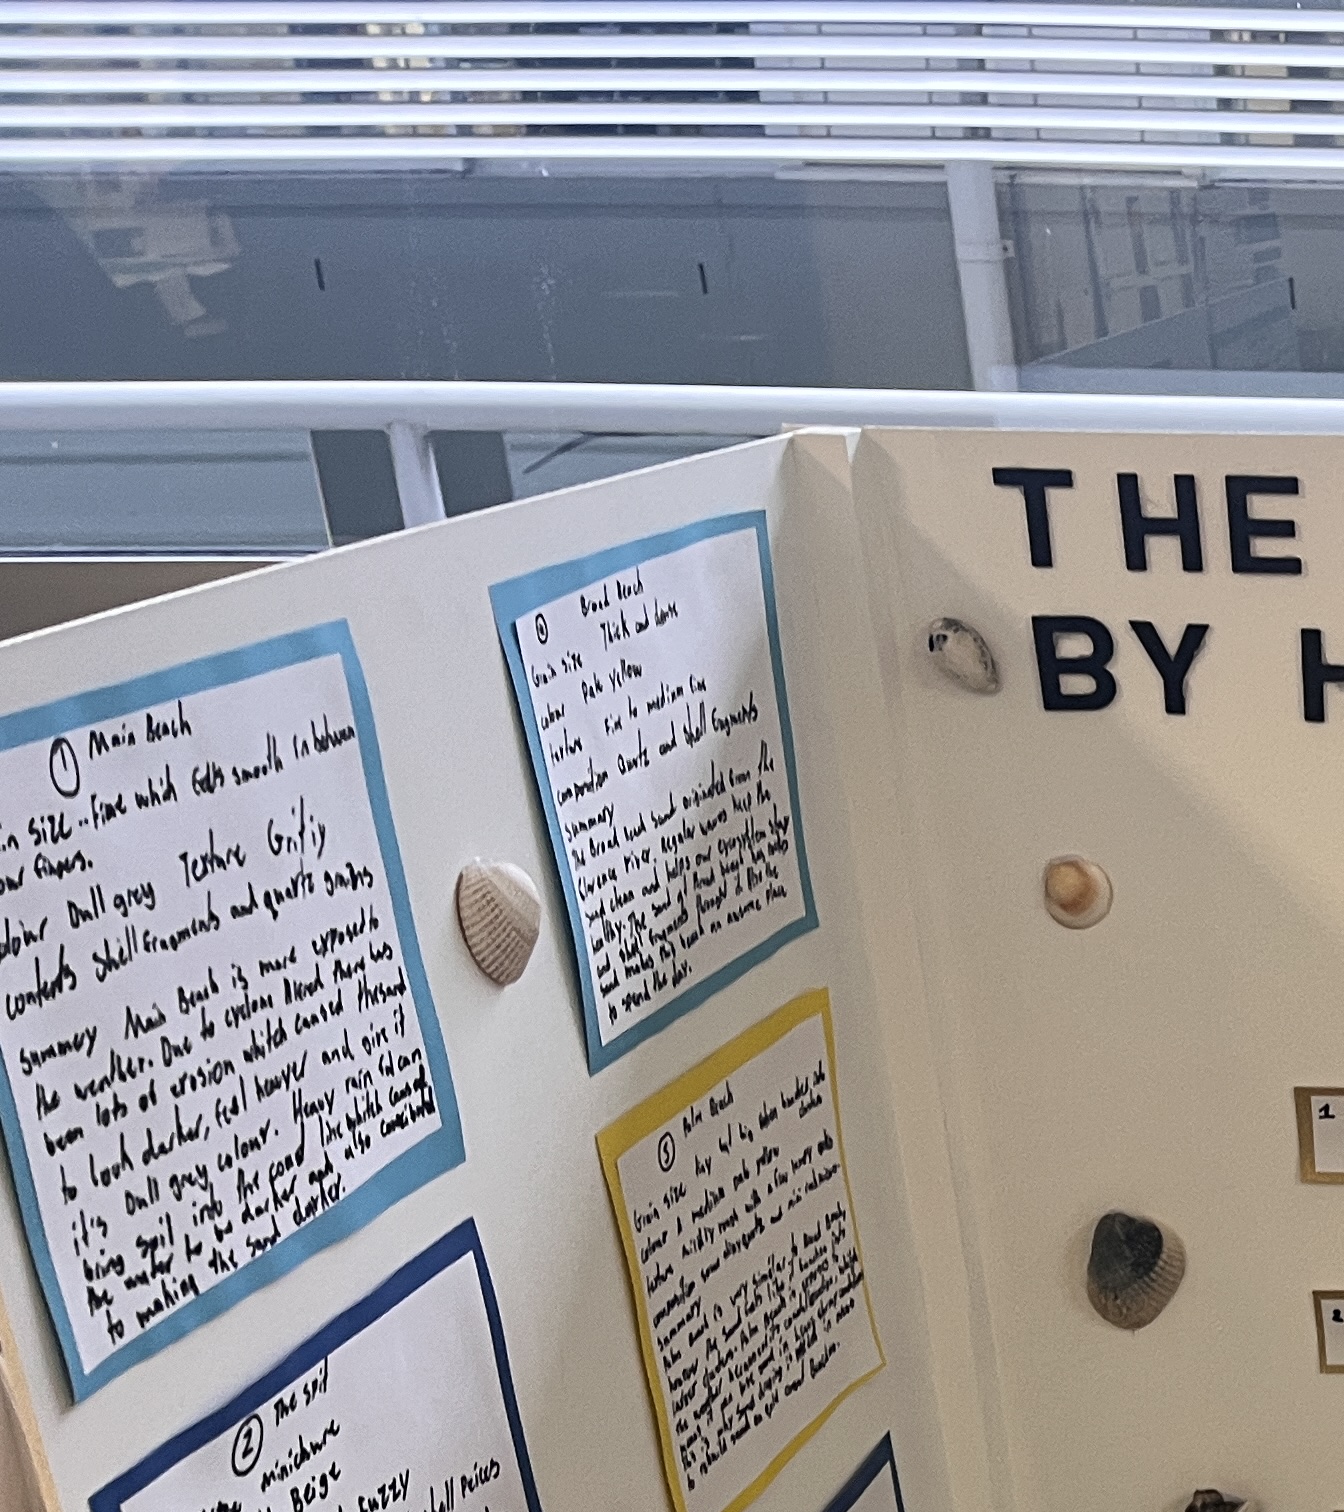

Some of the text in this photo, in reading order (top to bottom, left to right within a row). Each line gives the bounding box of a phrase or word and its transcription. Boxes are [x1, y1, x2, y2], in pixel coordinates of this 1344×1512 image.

[992, 468, 1302, 575] THE
[1032, 615, 1209, 715] BY
[89, 699, 192, 760] Main Beach
[232, 731, 284, 786] smooth
[67, 883, 106, 930] Dull
[113, 881, 156, 917] grey
[229, 881, 259, 920] and
[321, 1027, 355, 1066] and
[1319, 1103, 1335, 1119] 1
